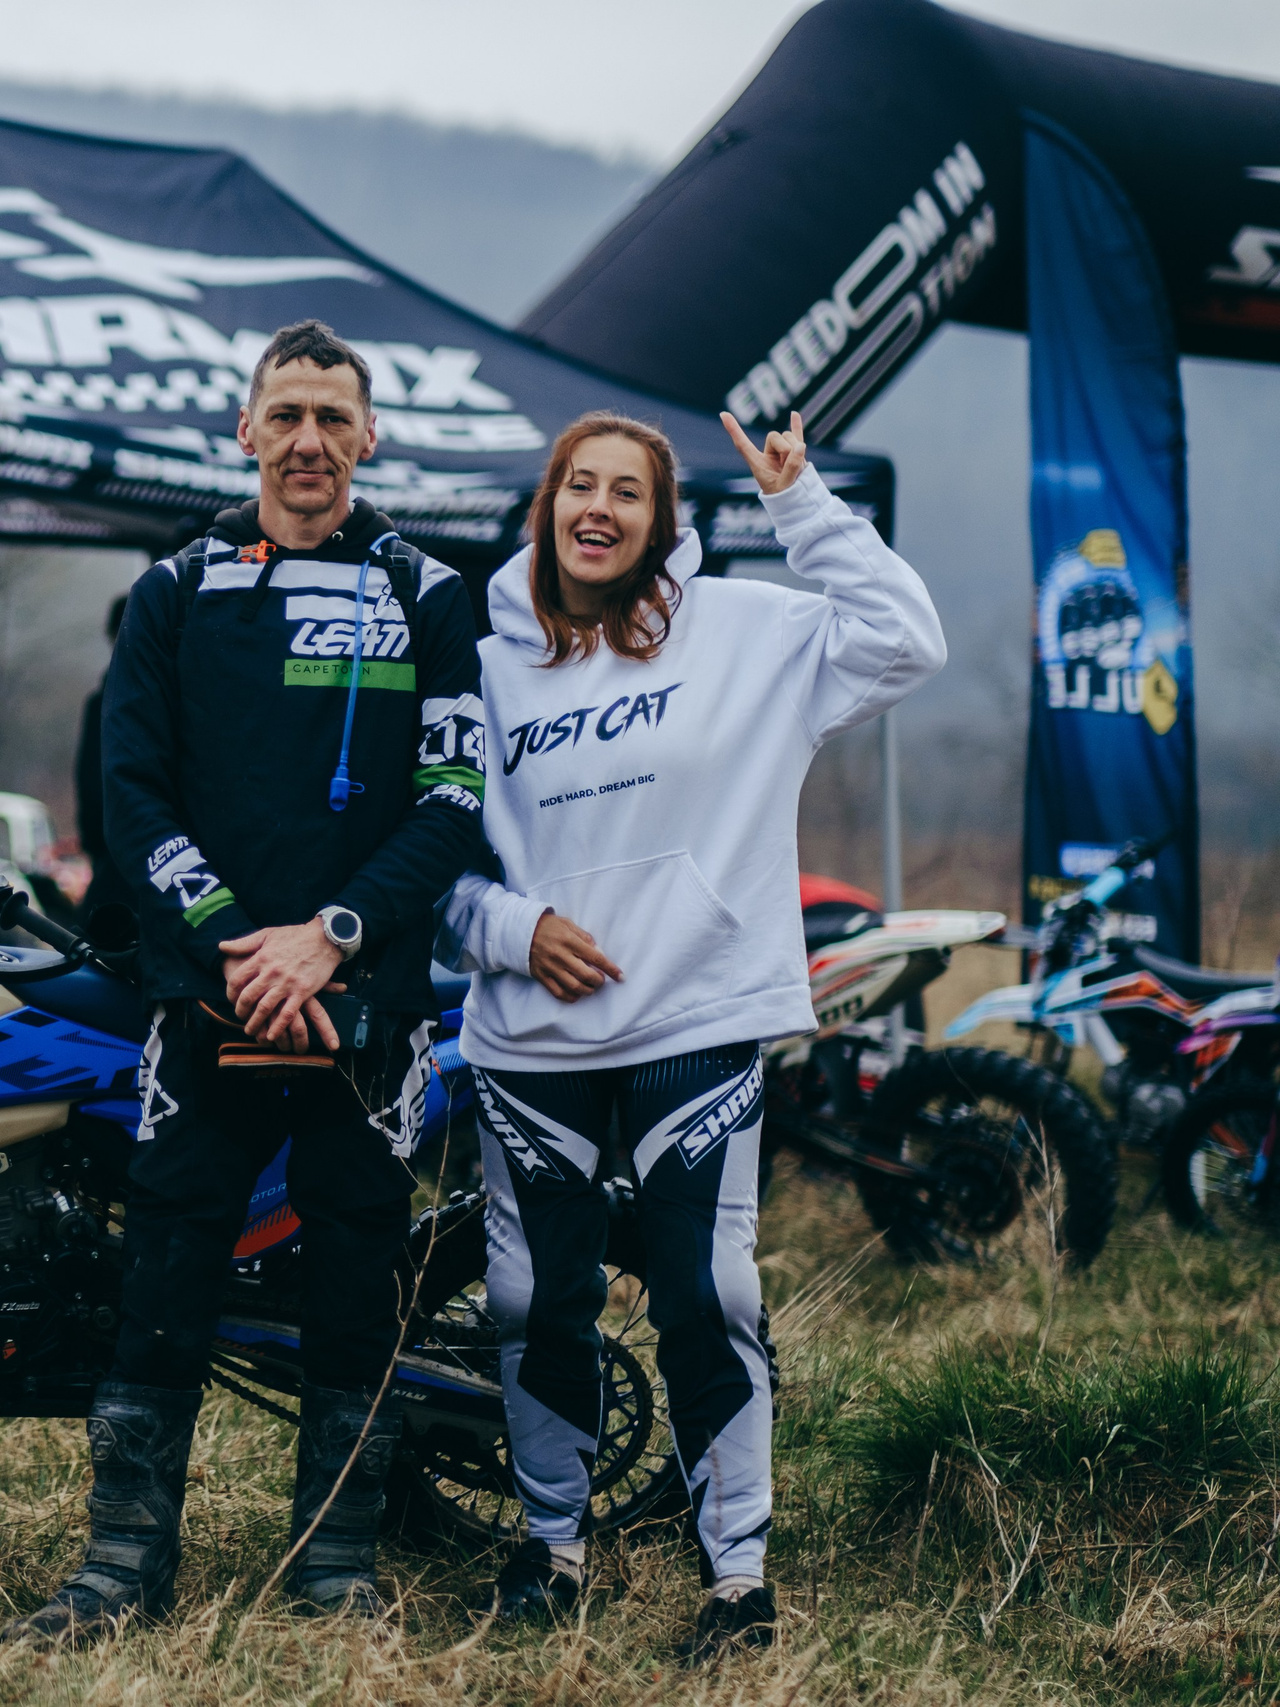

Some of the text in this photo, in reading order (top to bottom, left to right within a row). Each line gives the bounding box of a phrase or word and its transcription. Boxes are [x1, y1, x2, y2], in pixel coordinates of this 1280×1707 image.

[933, 140, 986, 217] IN
[503, 681, 687, 777] JUST CAT
[539, 773, 656, 809] RIDE HARD, DREAM BIG
[0, 1302, 40, 1312] FXmoto
